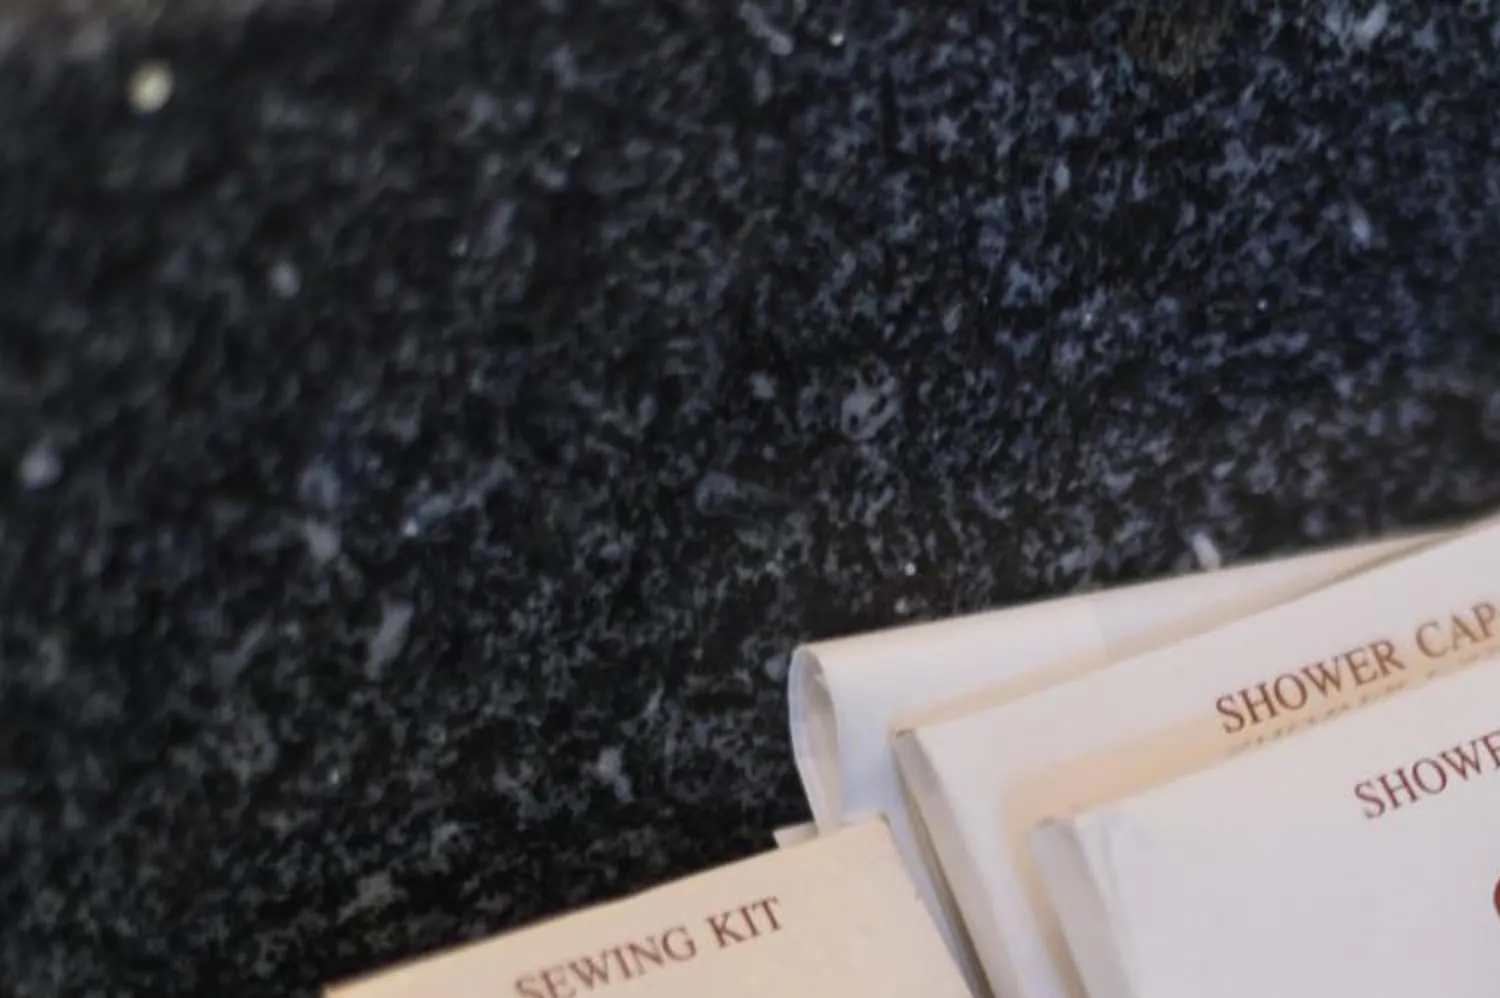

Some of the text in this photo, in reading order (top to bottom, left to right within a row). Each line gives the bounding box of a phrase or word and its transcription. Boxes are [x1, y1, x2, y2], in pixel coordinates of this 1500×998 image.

[1215, 602, 1498, 734] SHOWER CAP
[706, 896, 783, 950] KIT
